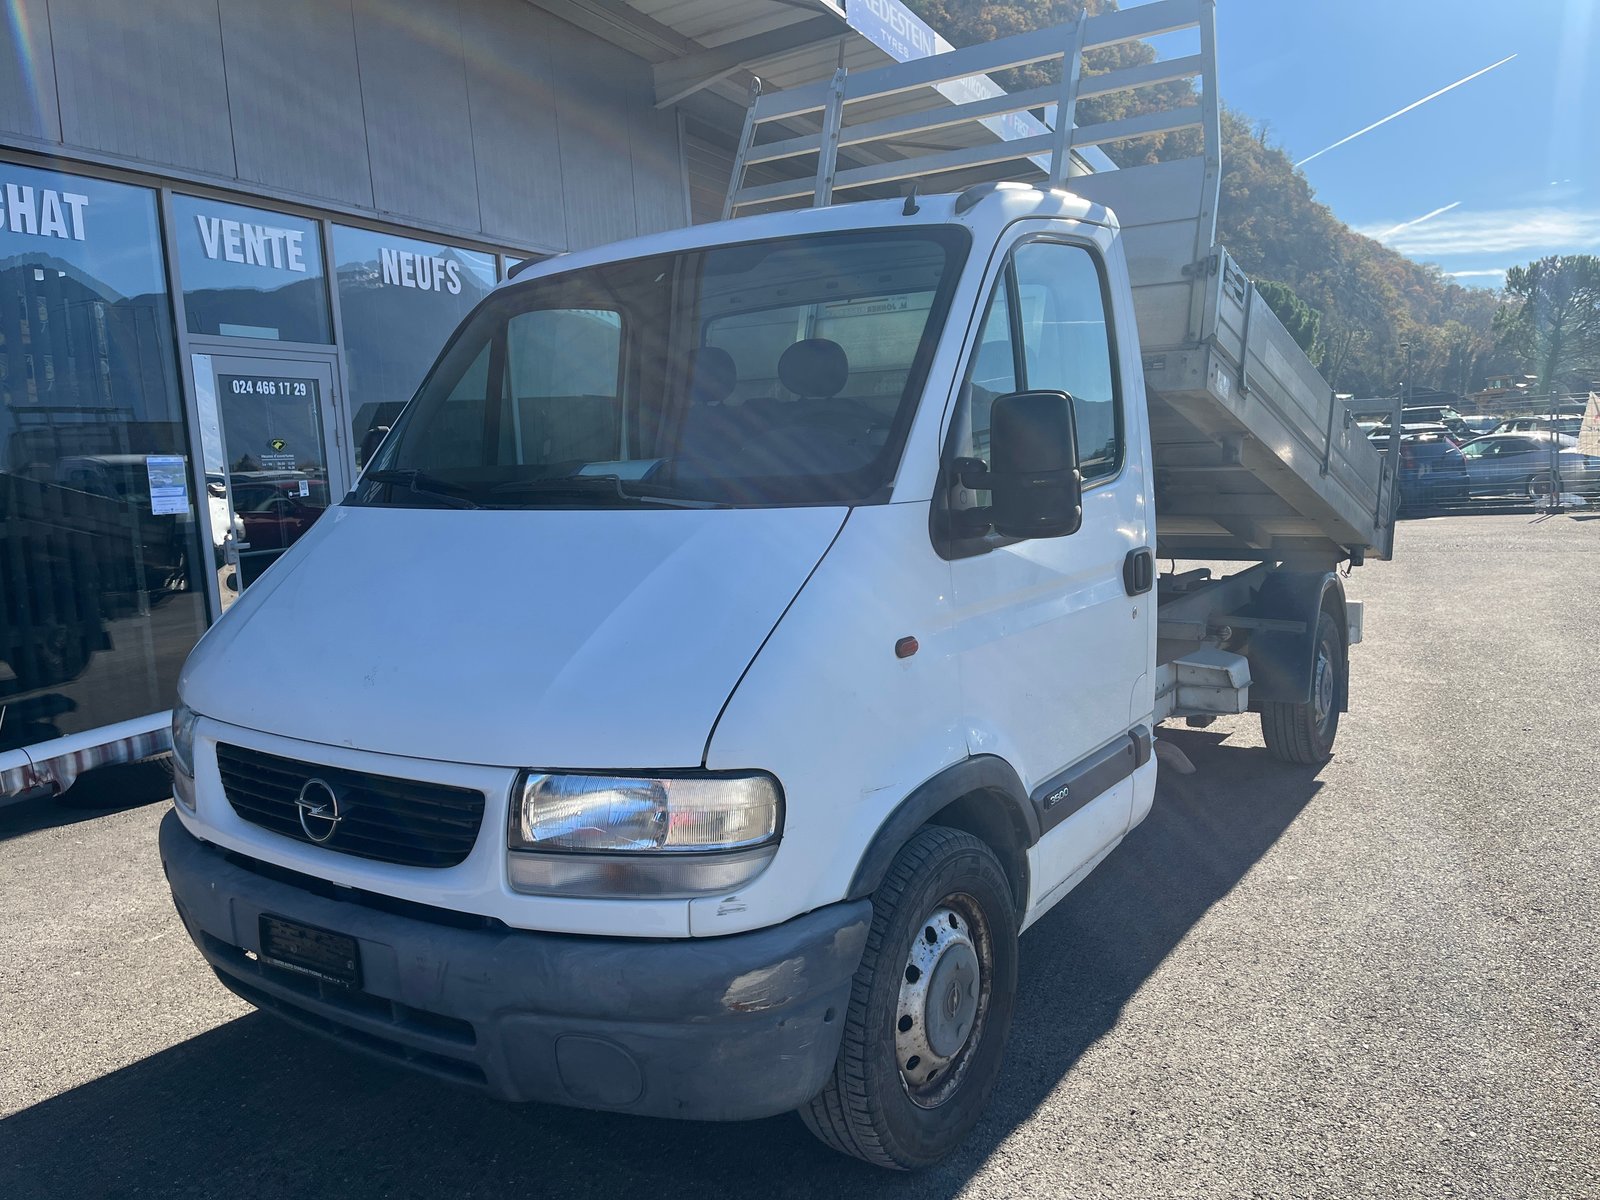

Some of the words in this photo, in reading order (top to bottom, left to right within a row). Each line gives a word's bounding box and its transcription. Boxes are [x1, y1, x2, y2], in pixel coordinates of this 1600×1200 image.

[865, 0, 932, 56] EDESTEIN
[880, 28, 909, 58] TYRES
[197, 214, 306, 272] VENTE
[381, 247, 462, 295] NEUFS
[232, 380, 253, 394] 024
[256, 381, 276, 395] 466
[279, 382, 290, 395] 17
[294, 383, 306, 396] 29
[1050, 787, 1069, 805] 3500
